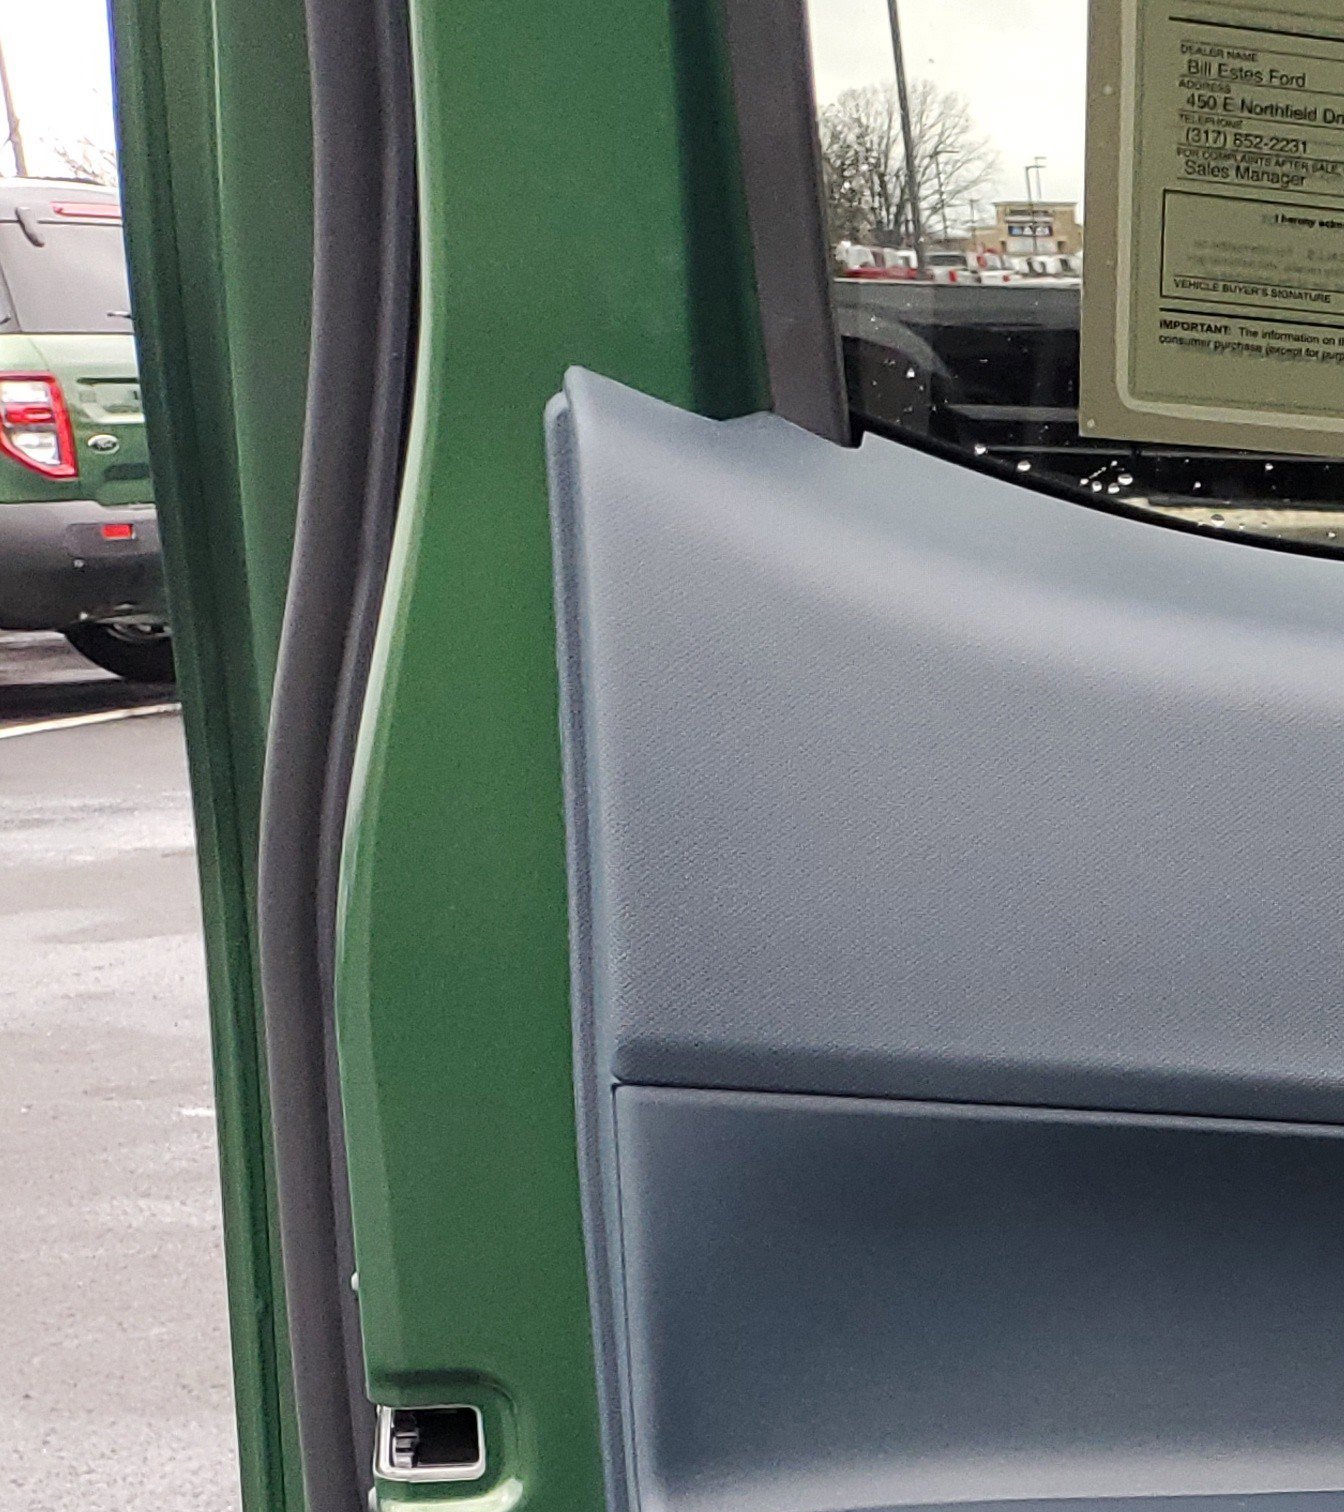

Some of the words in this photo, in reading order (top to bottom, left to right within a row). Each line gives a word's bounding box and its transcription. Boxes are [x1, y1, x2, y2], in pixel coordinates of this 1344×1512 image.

[1227, 50, 1258, 63] NAME
[1188, 58, 1212, 77] Bill
[1218, 63, 1264, 84] Estes
[1269, 69, 1307, 88] Ford
[1186, 93, 1218, 111] 450
[1223, 96, 1236, 113] E
[1240, 98, 1317, 123] Northfield
[1185, 126, 1228, 149] (317)
[1184, 159, 1230, 179] Sales
[1235, 165, 1307, 190] Manager
[1173, 278, 1220, 293] VEHICLE
[1270, 289, 1331, 304] SIGNATURE
[1159, 334, 1212, 348] consumer
[1213, 338, 1262, 355] purchase
[1305, 347, 1319, 359] for
[1239, 326, 1259, 339] The
[1261, 329, 1320, 345] information
[1322, 335, 1336, 346] on
